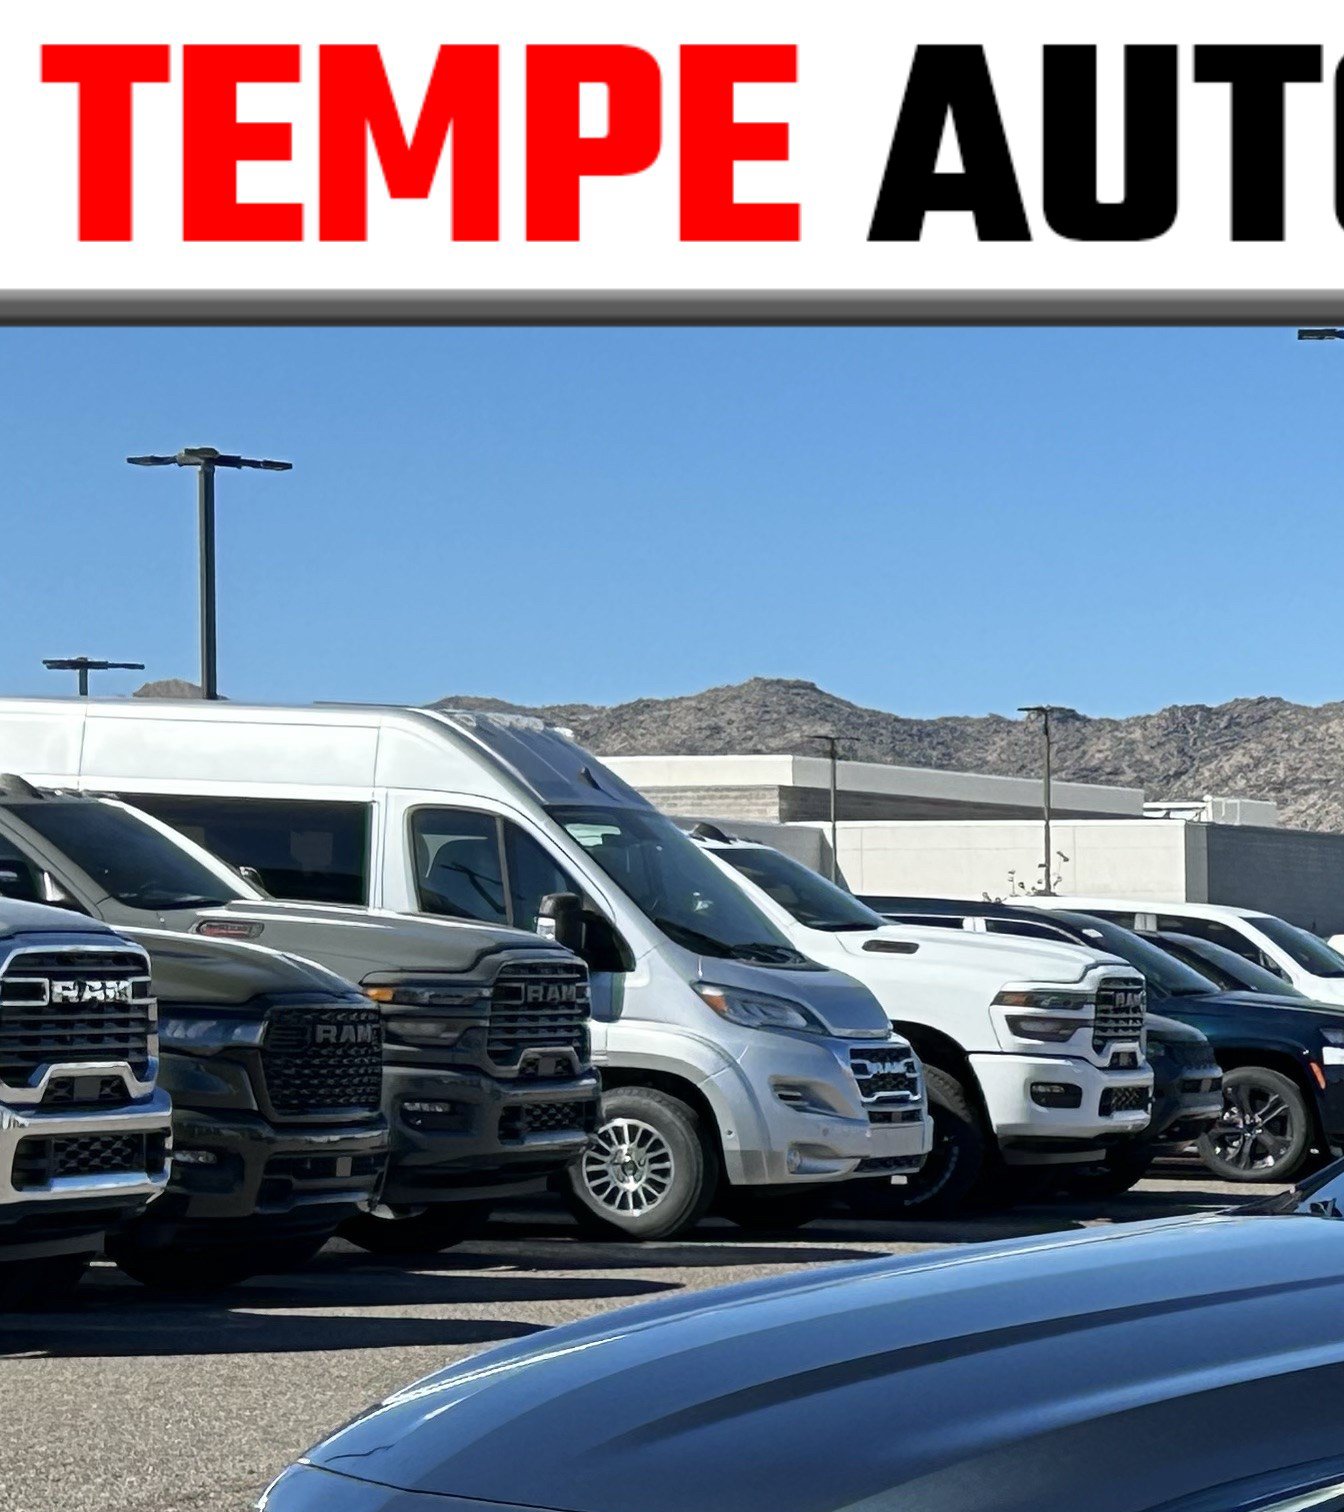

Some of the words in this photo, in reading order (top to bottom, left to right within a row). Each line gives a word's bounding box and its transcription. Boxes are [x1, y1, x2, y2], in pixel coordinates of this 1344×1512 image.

[52, 980, 132, 1003] RAM
[527, 984, 577, 1003] RAM
[316, 1024, 373, 1043] RAM
